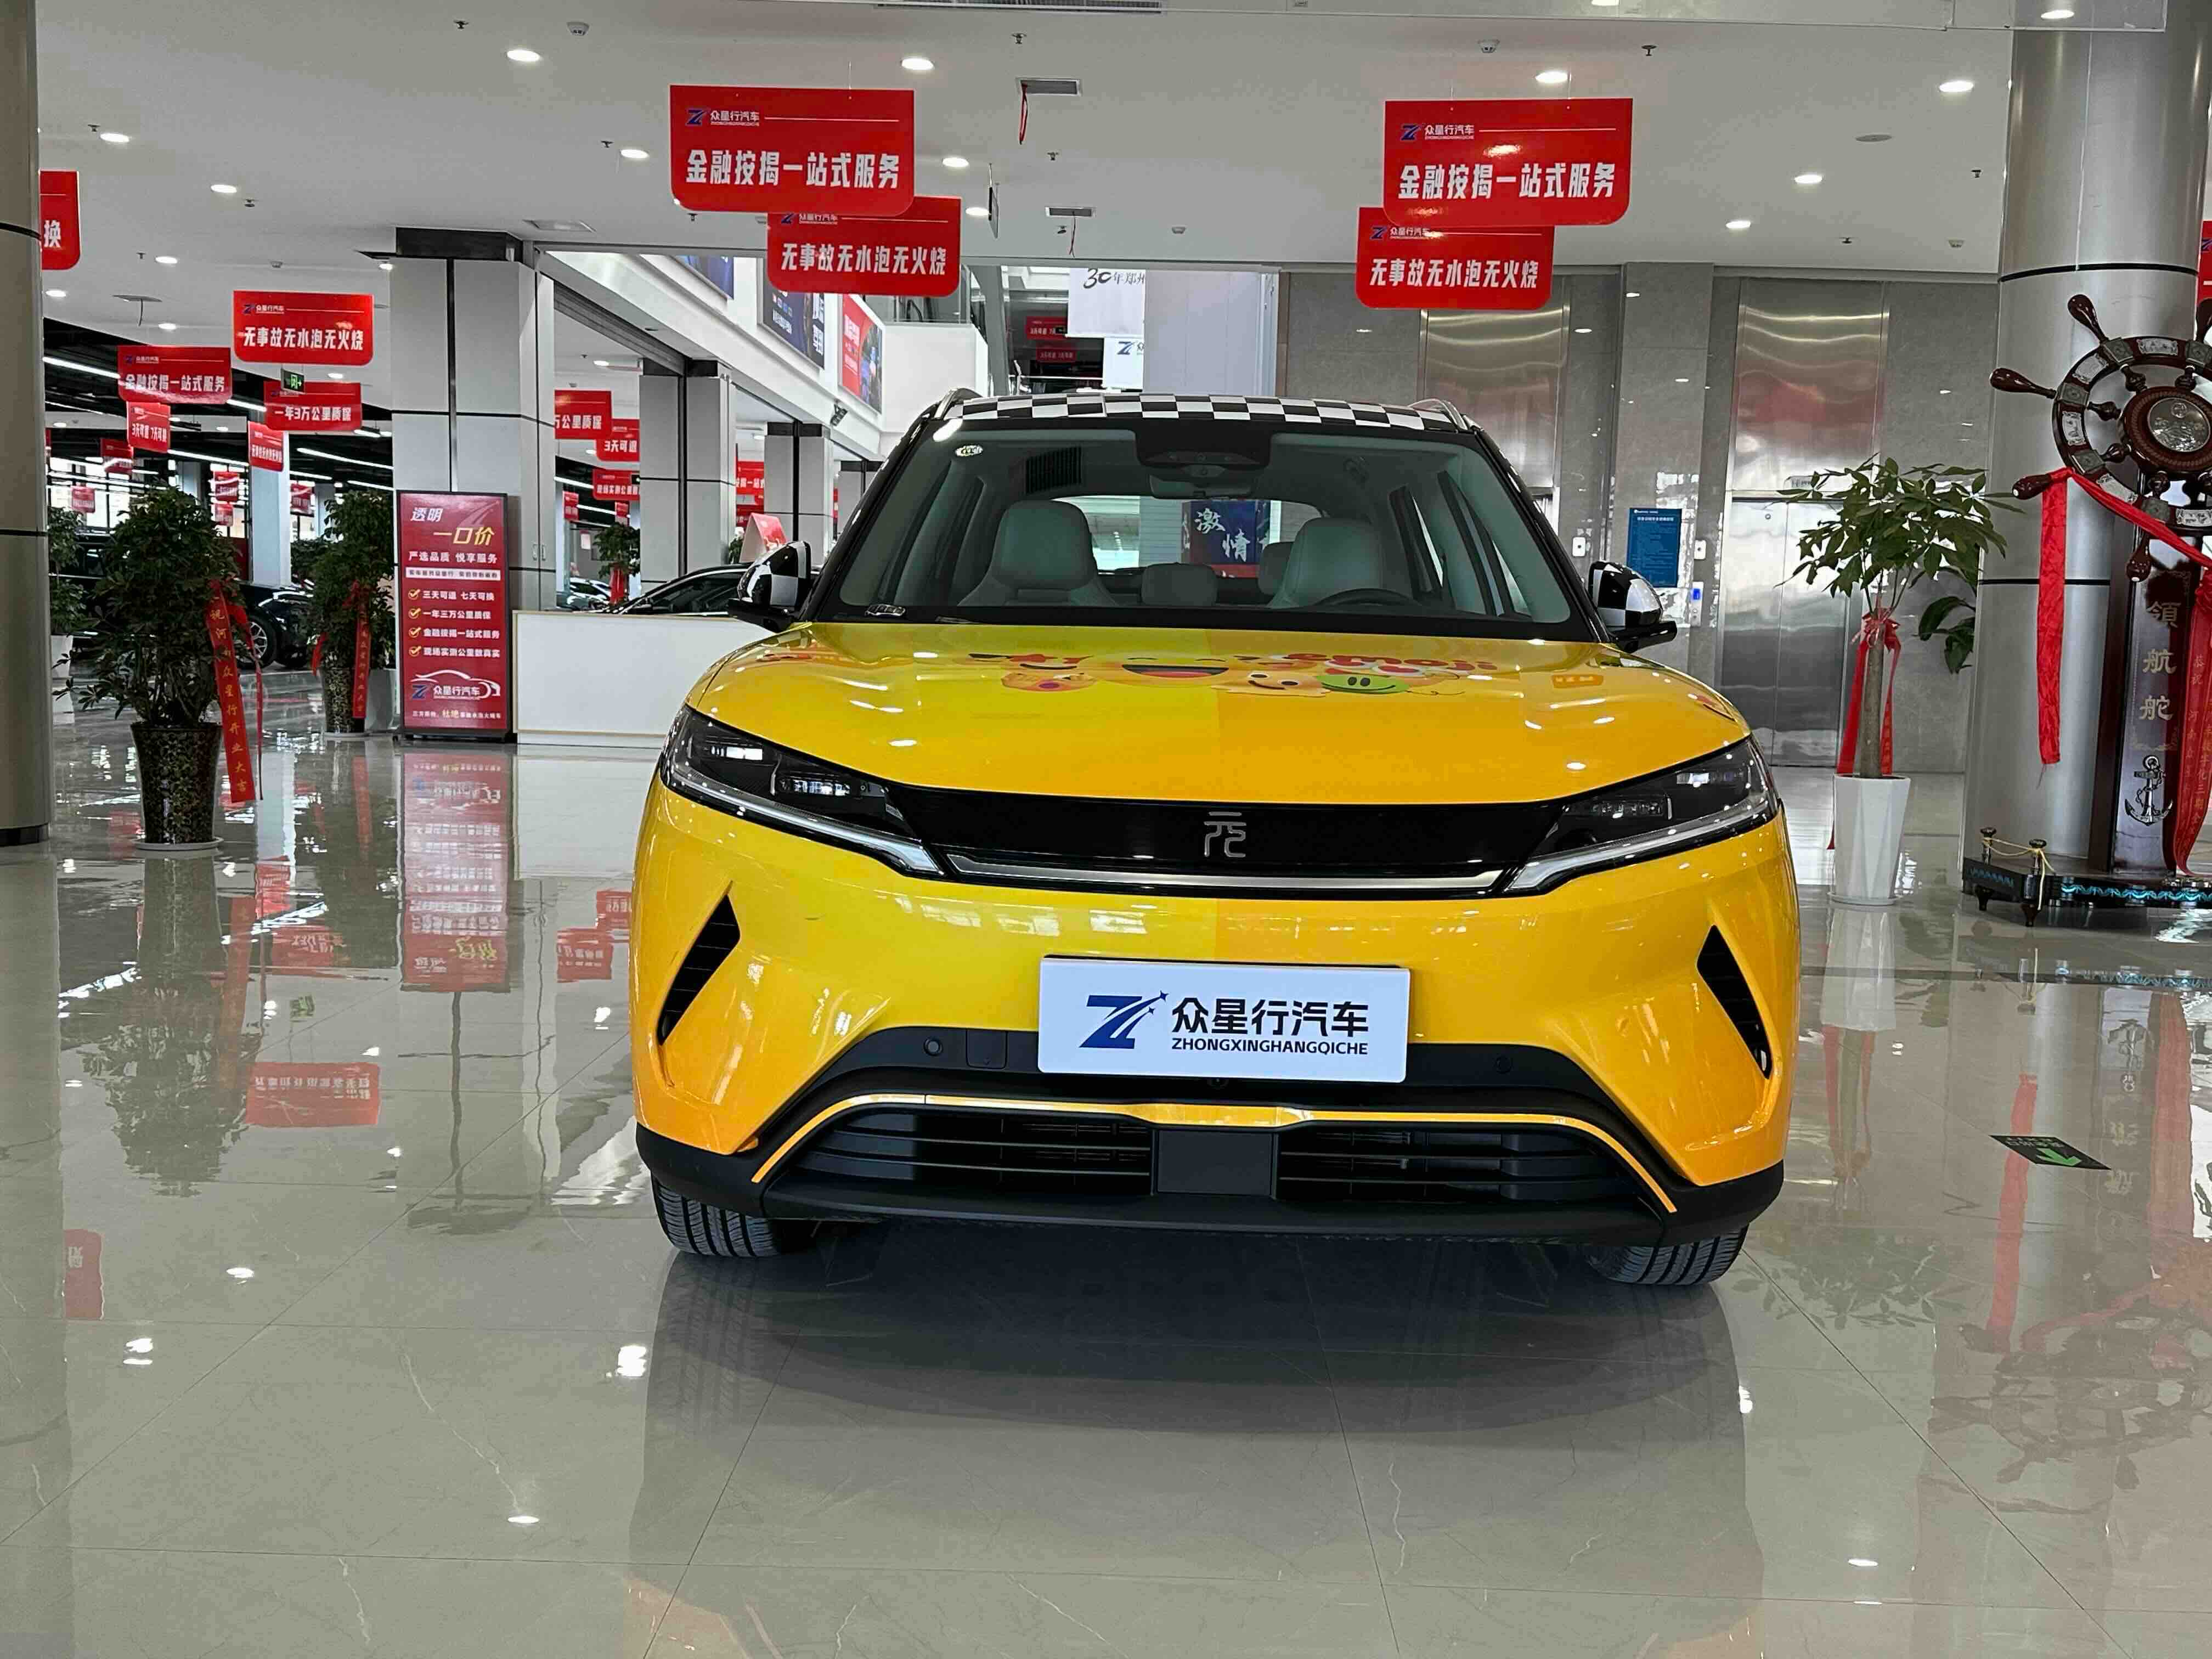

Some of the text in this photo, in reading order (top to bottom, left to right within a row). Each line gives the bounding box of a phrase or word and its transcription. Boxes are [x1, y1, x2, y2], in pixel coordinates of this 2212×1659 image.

[686, 149, 900, 189] 金融按揭一站式服务
[1398, 162, 1616, 200] 金融按揭一站式服务
[43, 219, 61, 248] 换
[781, 242, 946, 275] 无事故无水泡无火烧
[1369, 258, 1539, 289] 无事故无水泡无火烧
[243, 326, 364, 352] 无事故无水泡无火烧
[125, 374, 225, 392] 金融按揭一站式服务
[274, 407, 352, 422] 一年3万公里质保
[410, 507, 443, 522] 透明
[433, 527, 495, 546] 一口价
[408, 551, 498, 564] 严选品质 悦享服务
[422, 610, 491, 619] 一年三万公里质保
[1171, 997, 1369, 1037] 众星行汽车
[1171, 1037, 1369, 1056] ZHONGXINGHANGQICHE
